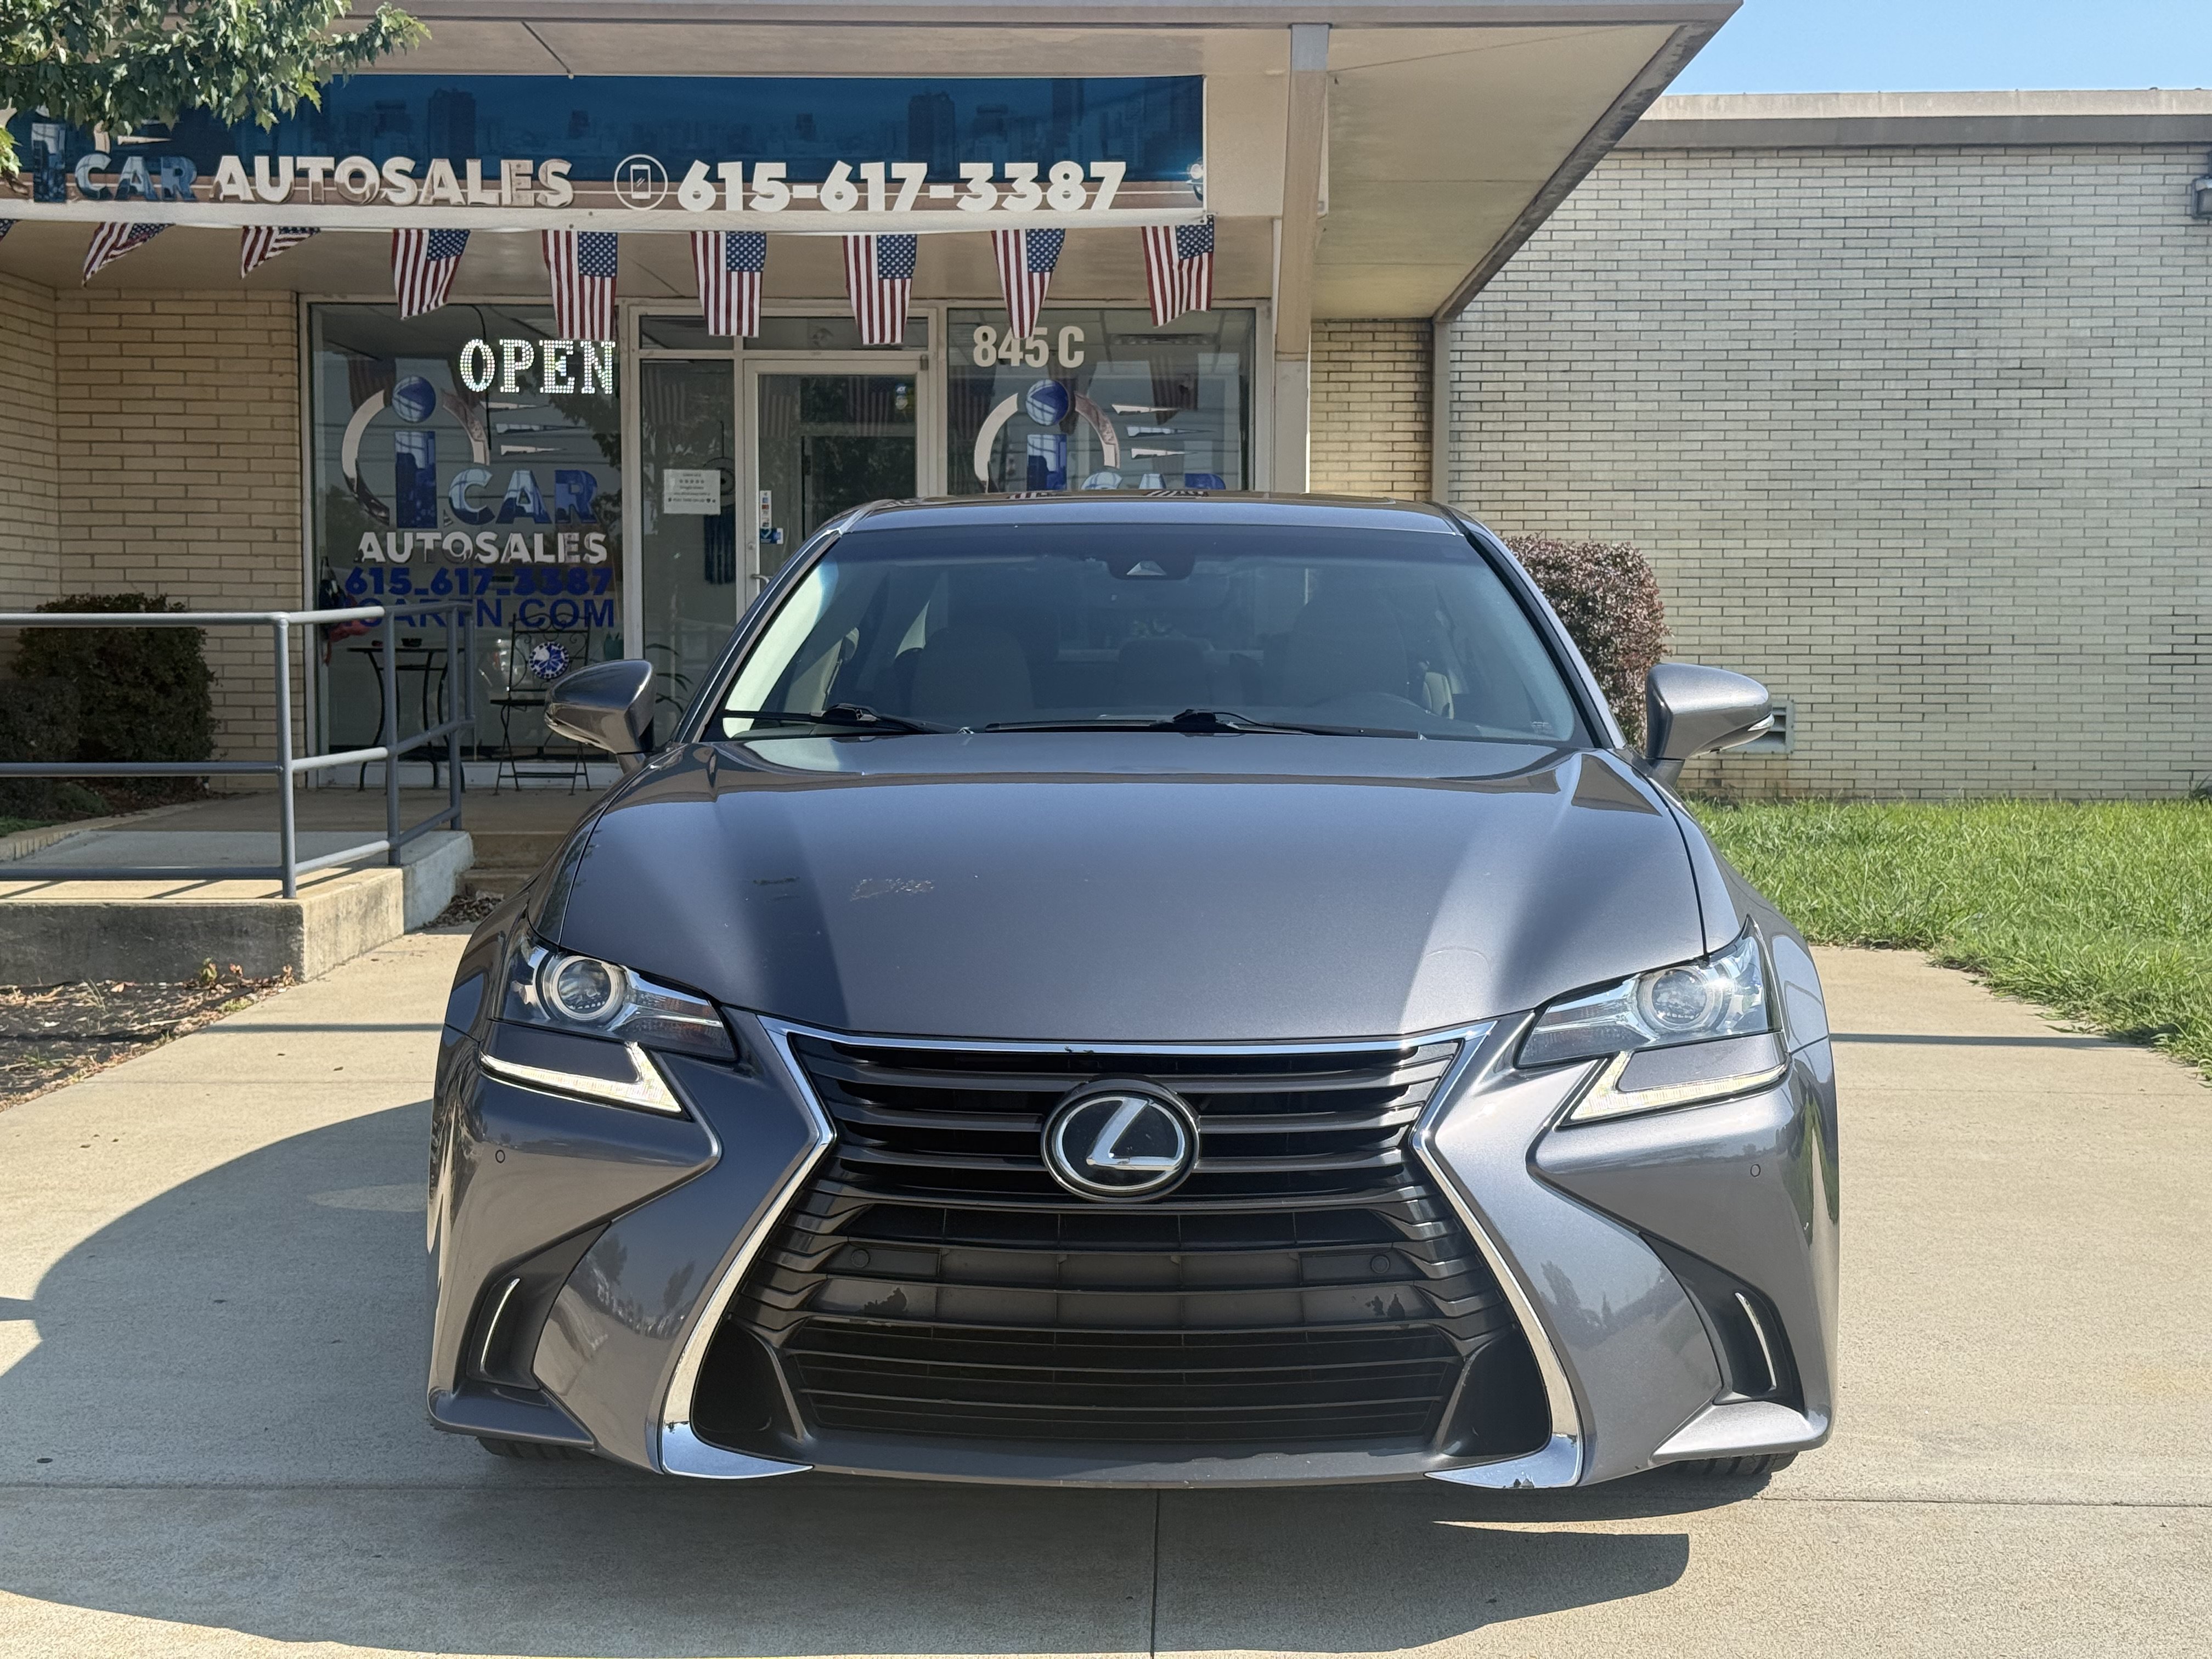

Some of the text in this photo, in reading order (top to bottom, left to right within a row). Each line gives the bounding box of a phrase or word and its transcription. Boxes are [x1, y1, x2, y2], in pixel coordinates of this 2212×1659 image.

[210, 155, 574, 207] AUTOSALES
[677, 160, 1126, 212] 615-617-3387
[459, 338, 616, 394] OPEN
[973, 326, 1084, 368] 845 C
[354, 531, 607, 563] AUTOSALES
